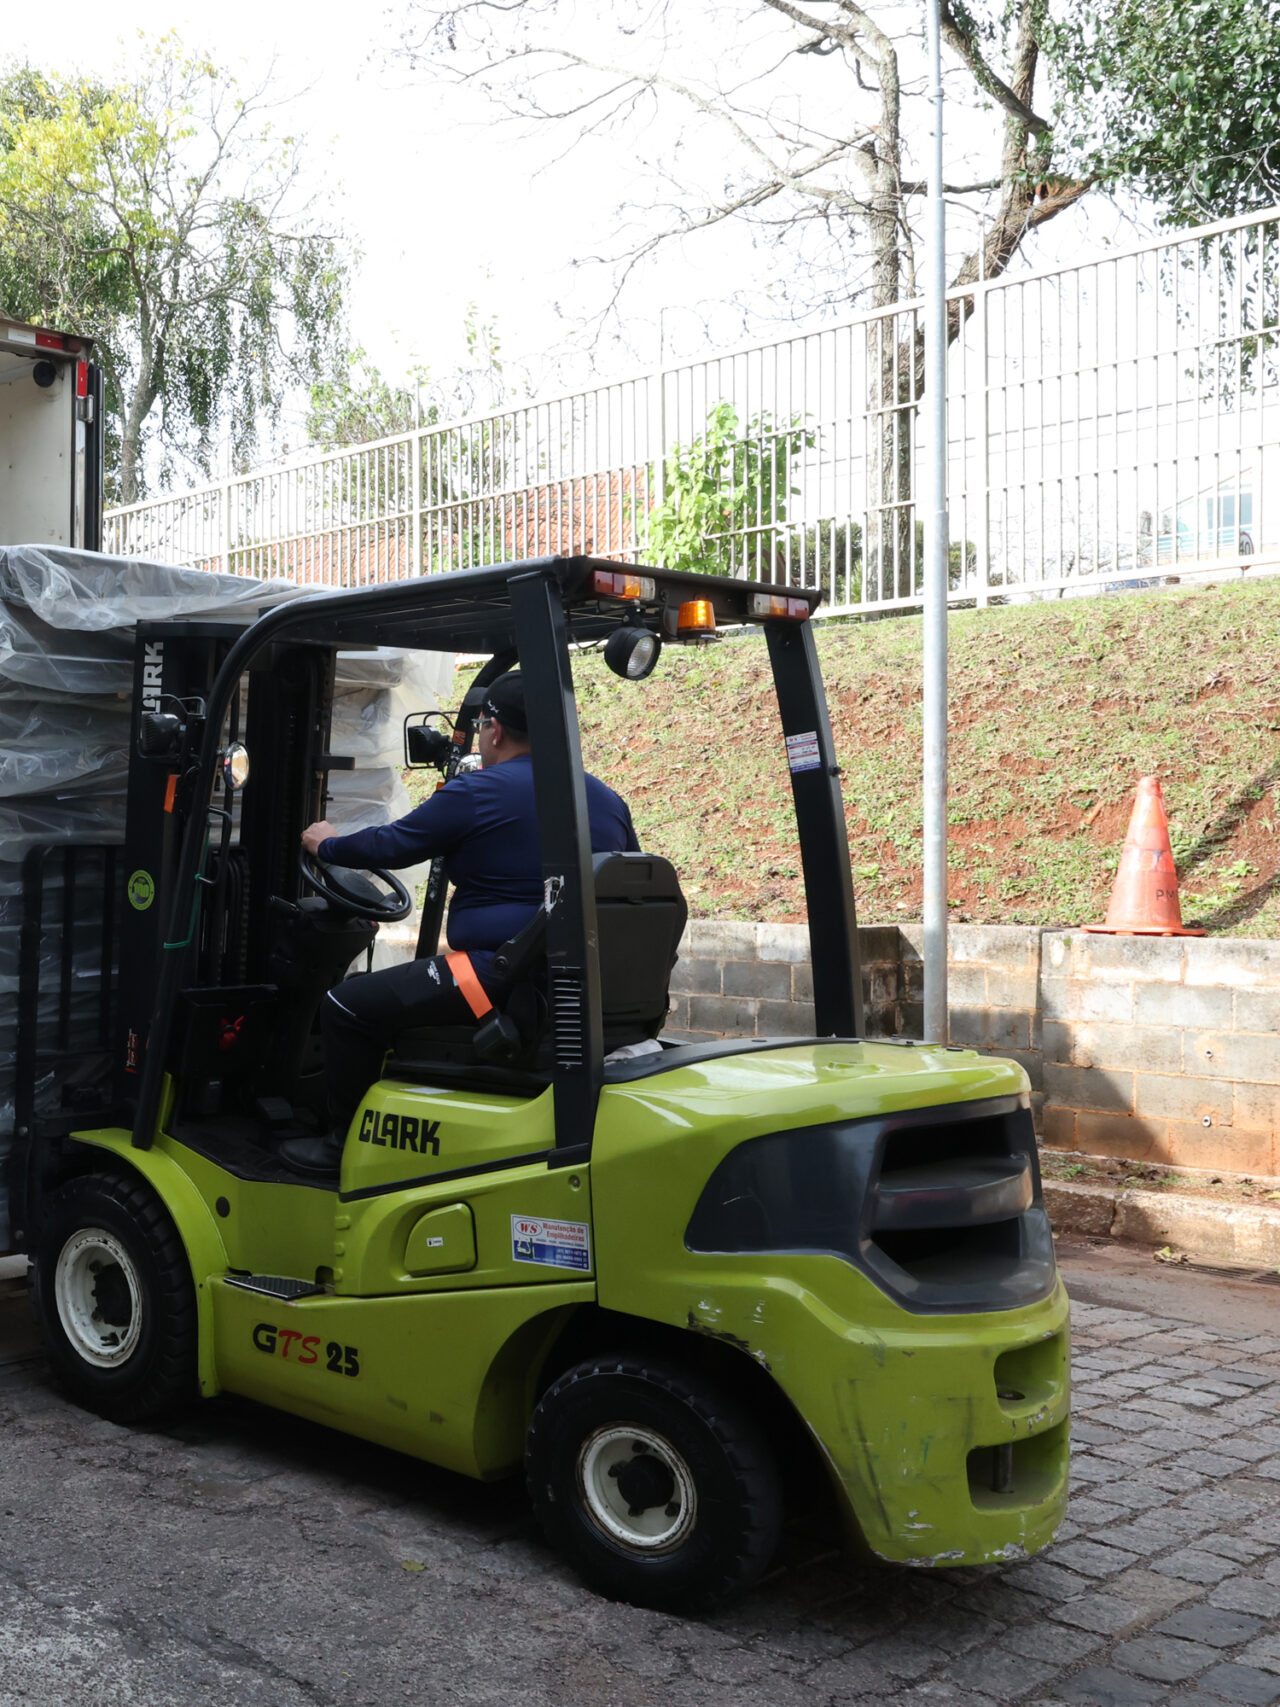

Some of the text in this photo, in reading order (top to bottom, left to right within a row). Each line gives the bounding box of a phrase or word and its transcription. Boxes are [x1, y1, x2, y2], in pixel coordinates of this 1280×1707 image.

[141, 641, 164, 716] LARK
[358, 1108, 441, 1157] CLARK
[520, 1223, 537, 1234] WS
[543, 1223, 576, 1232] Manutenção
[547, 1231, 584, 1242] Empilhadeiras
[252, 1322, 360, 1378] GTS 25
